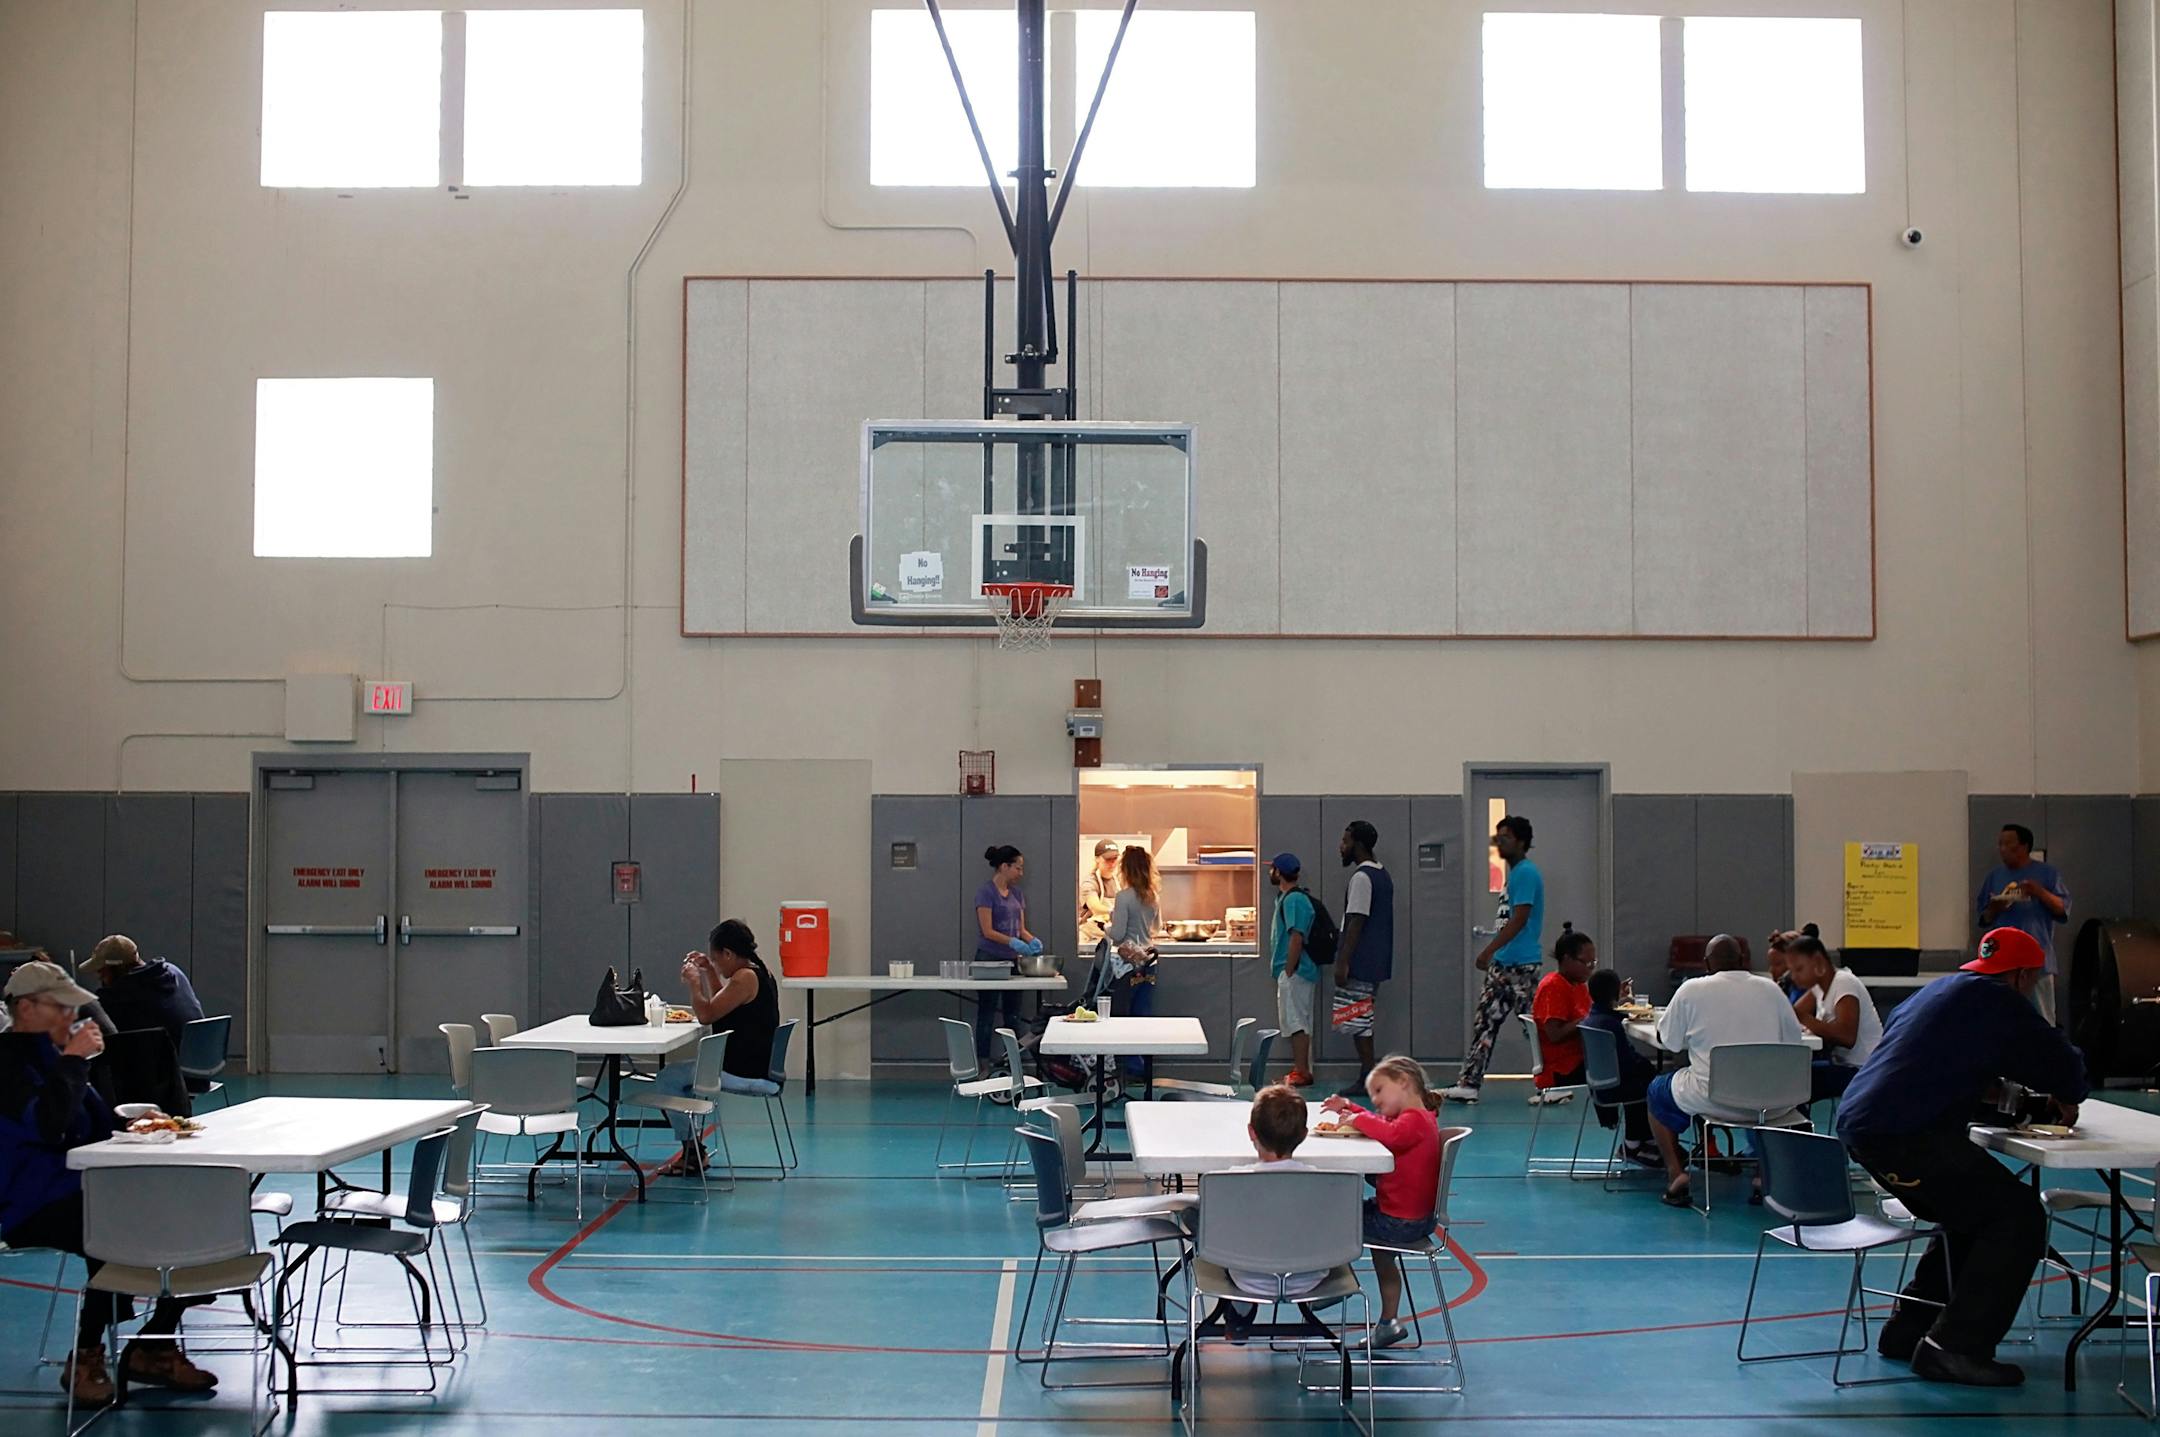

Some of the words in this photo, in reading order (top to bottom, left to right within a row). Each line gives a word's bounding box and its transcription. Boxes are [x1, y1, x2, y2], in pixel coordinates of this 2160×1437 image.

[917, 558, 928, 568] No
[1131, 568, 1141, 577] No
[1141, 568, 1168, 579] Hanging
[372, 686, 402, 710] EXIT
[293, 867, 330, 877] EMERGENCY
[332, 867, 346, 877] EXIT
[348, 867, 364, 877] ONLY
[424, 869, 462, 878] EMERGENCY
[464, 869, 478, 878] EXIT
[479, 869, 496, 878] ONLY
[298, 879, 321, 888] ALARM
[322, 879, 337, 888] WILL
[429, 880, 453, 889] ALARM
[454, 880, 468, 889] WILL
